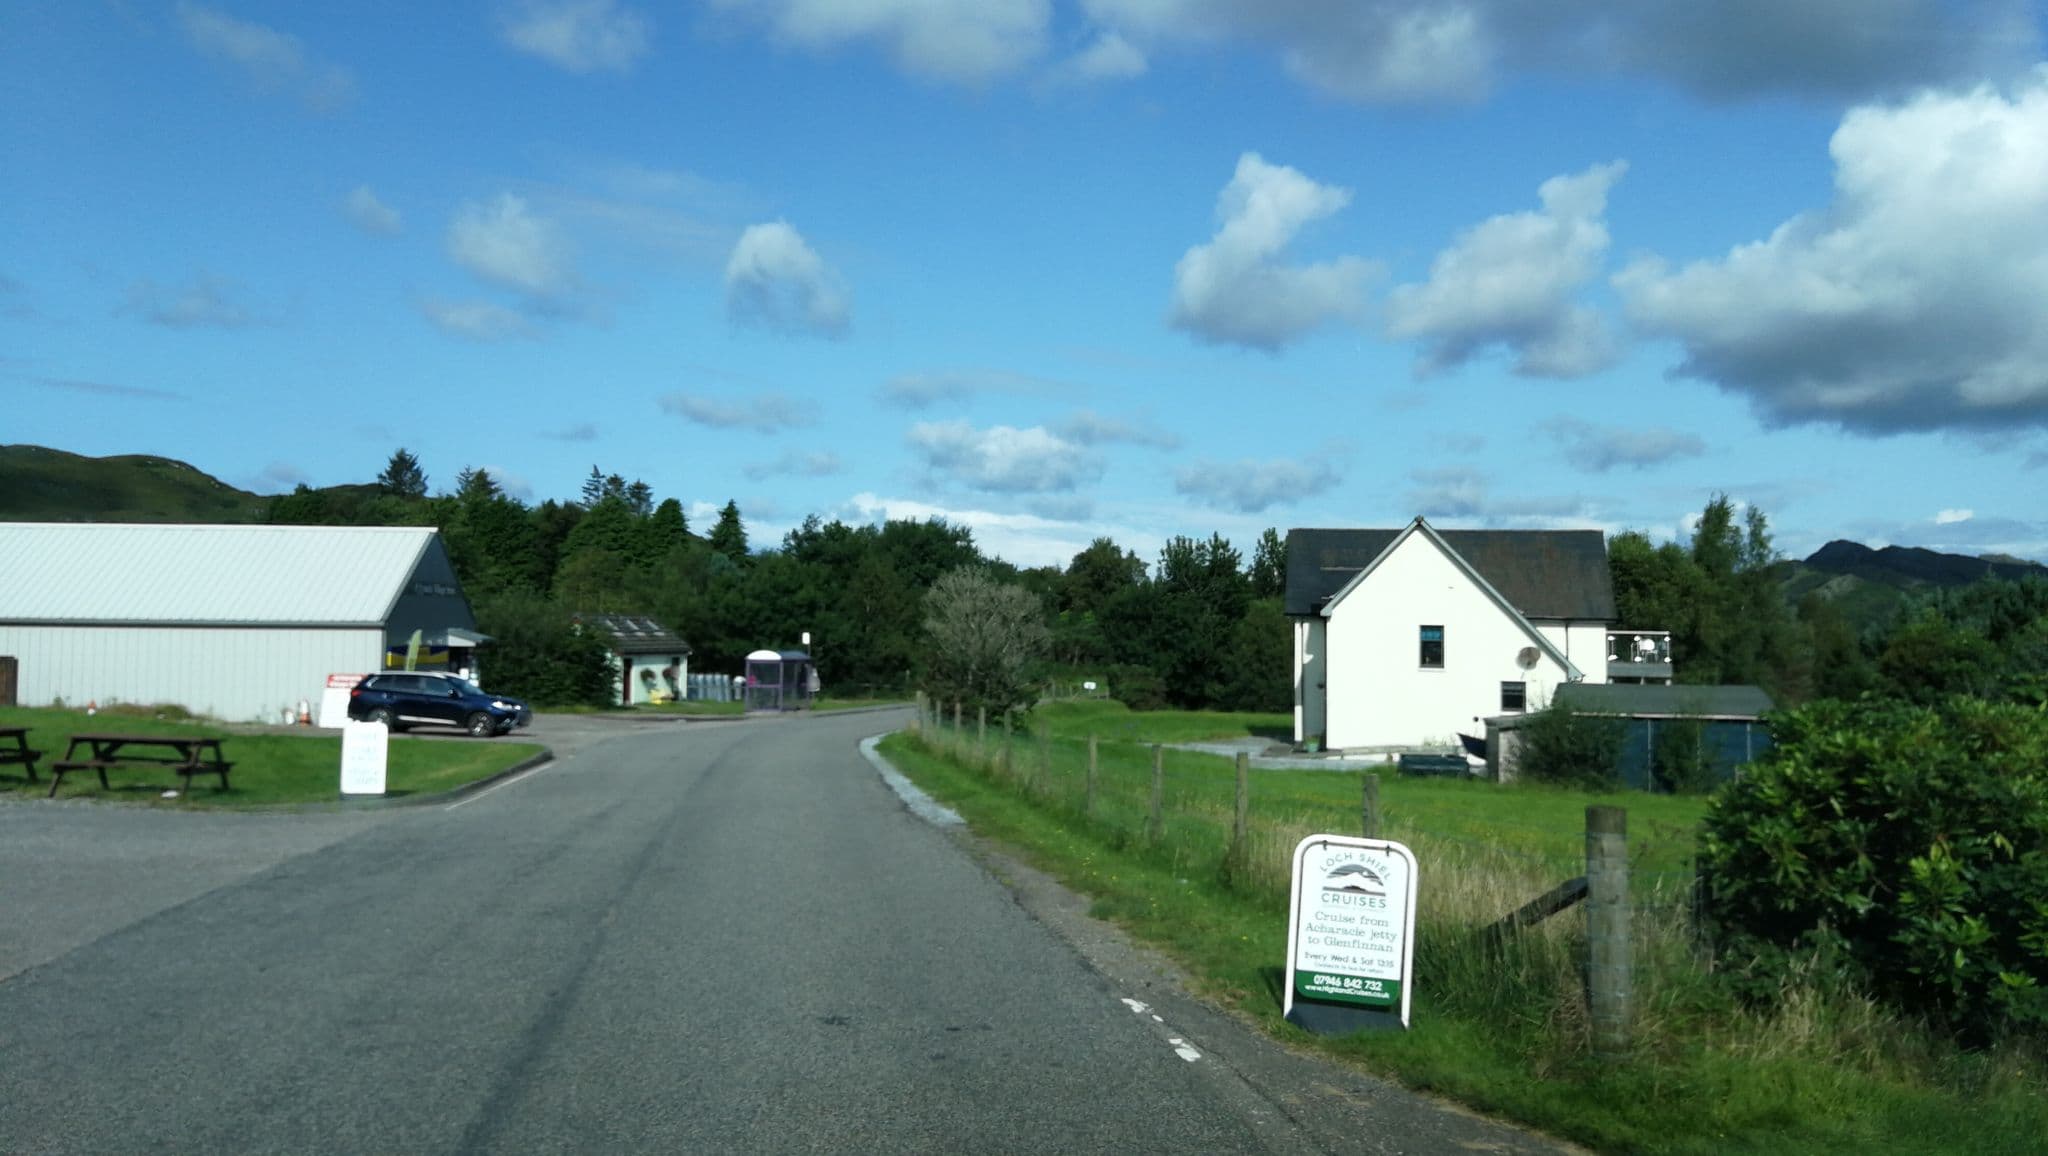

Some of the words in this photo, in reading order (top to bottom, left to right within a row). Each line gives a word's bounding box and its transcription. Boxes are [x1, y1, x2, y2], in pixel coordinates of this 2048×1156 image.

[1320, 852, 1352, 872] LOCH
[1359, 853, 1391, 880] SHIEL
[1321, 893, 1386, 908] CRUISES
[1315, 911, 1355, 924] Cruise
[1360, 915, 1389, 927] from
[1305, 922, 1365, 937] Acharacle
[1308, 936, 1320, 944] to
[1324, 936, 1393, 952] Glenfinnan
[1304, 951, 1327, 961] Every
[1331, 954, 1349, 963] Wed
[1352, 956, 1358, 964] &
[1361, 957, 1374, 966] Sat
[1313, 974, 1342, 987] 07946
[1364, 980, 1383, 991] 732
